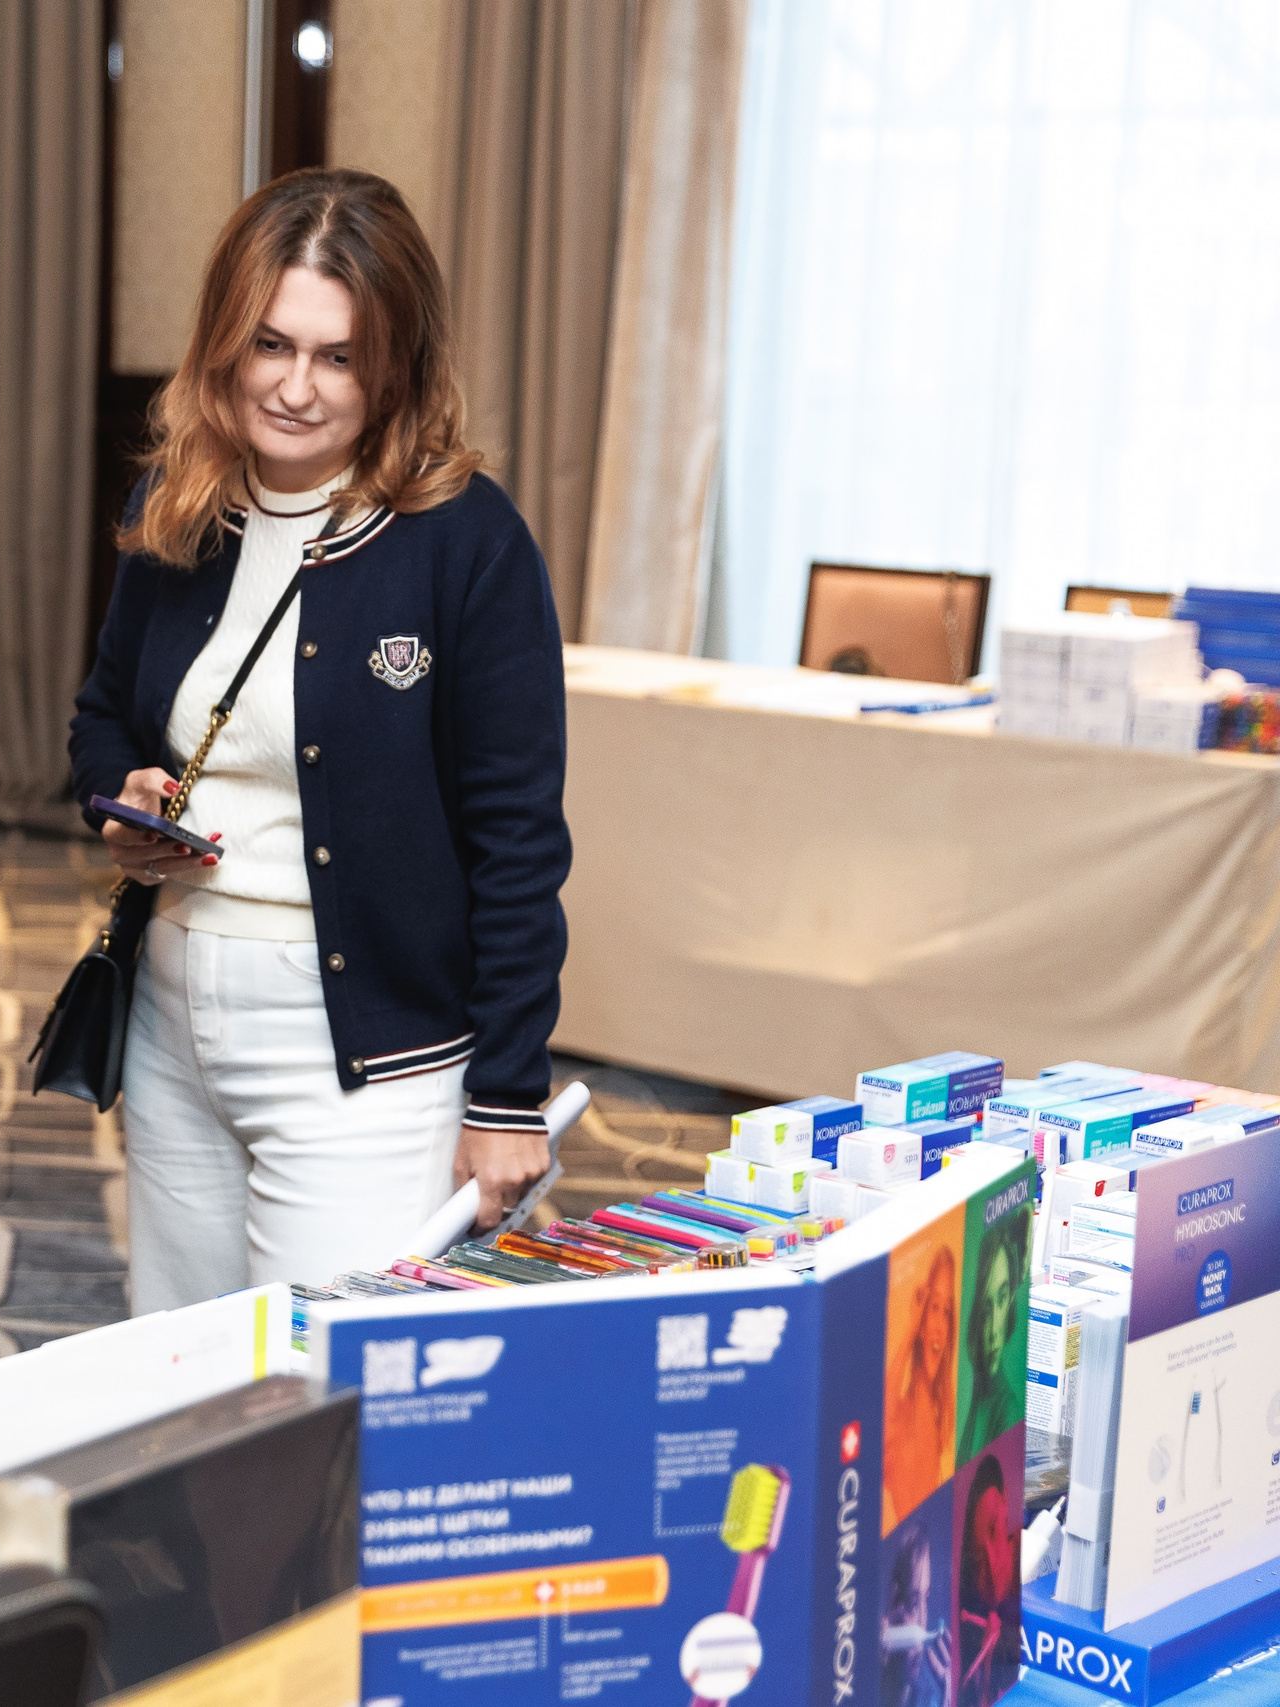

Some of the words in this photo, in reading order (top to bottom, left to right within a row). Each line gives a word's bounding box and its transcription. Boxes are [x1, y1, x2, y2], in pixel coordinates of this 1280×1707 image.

[986, 1178, 1029, 1223] CURAPROX
[1180, 1182, 1232, 1213] CURAPROX
[1176, 1203, 1246, 1242] HYDROSONIC
[1175, 1243, 1196, 1263] PRO
[1214, 1259, 1225, 1270] DAY
[1202, 1269, 1227, 1286] MONEY
[1204, 1283, 1223, 1297] BACK
[435, 1478, 508, 1507] ДЕЛАЕТ
[510, 1473, 572, 1498] НАШИ
[834, 1467, 860, 1706] CURAPROX
